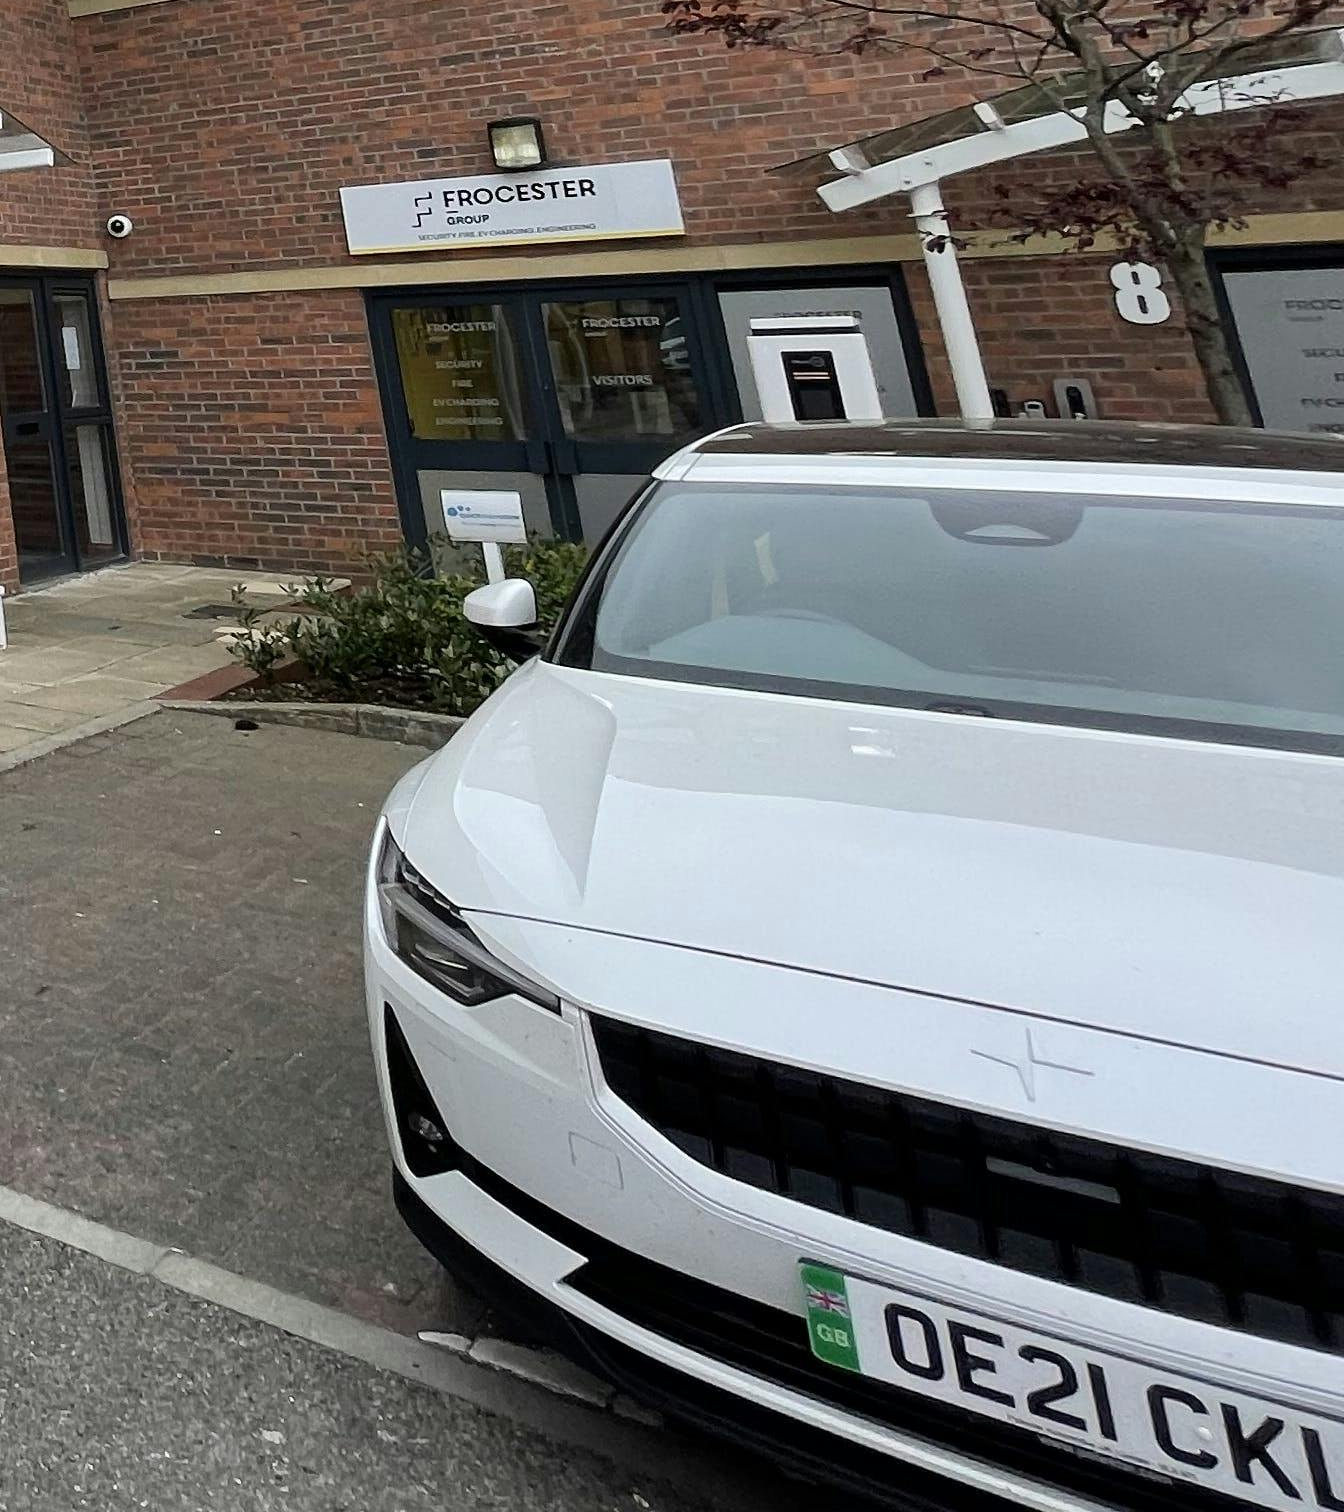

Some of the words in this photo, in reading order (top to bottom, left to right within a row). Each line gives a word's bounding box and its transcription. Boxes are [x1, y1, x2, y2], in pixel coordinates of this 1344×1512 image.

[443, 179, 596, 208] FROCESTER
[446, 214, 490, 226] GROUP
[1109, 261, 1171, 325] 8
[426, 321, 497, 334] FROCESTER
[582, 316, 661, 328] FROCESTER
[592, 374, 653, 386] VISITORS
[816, 1323, 849, 1348] GB
[884, 1302, 1117, 1442] OE21
